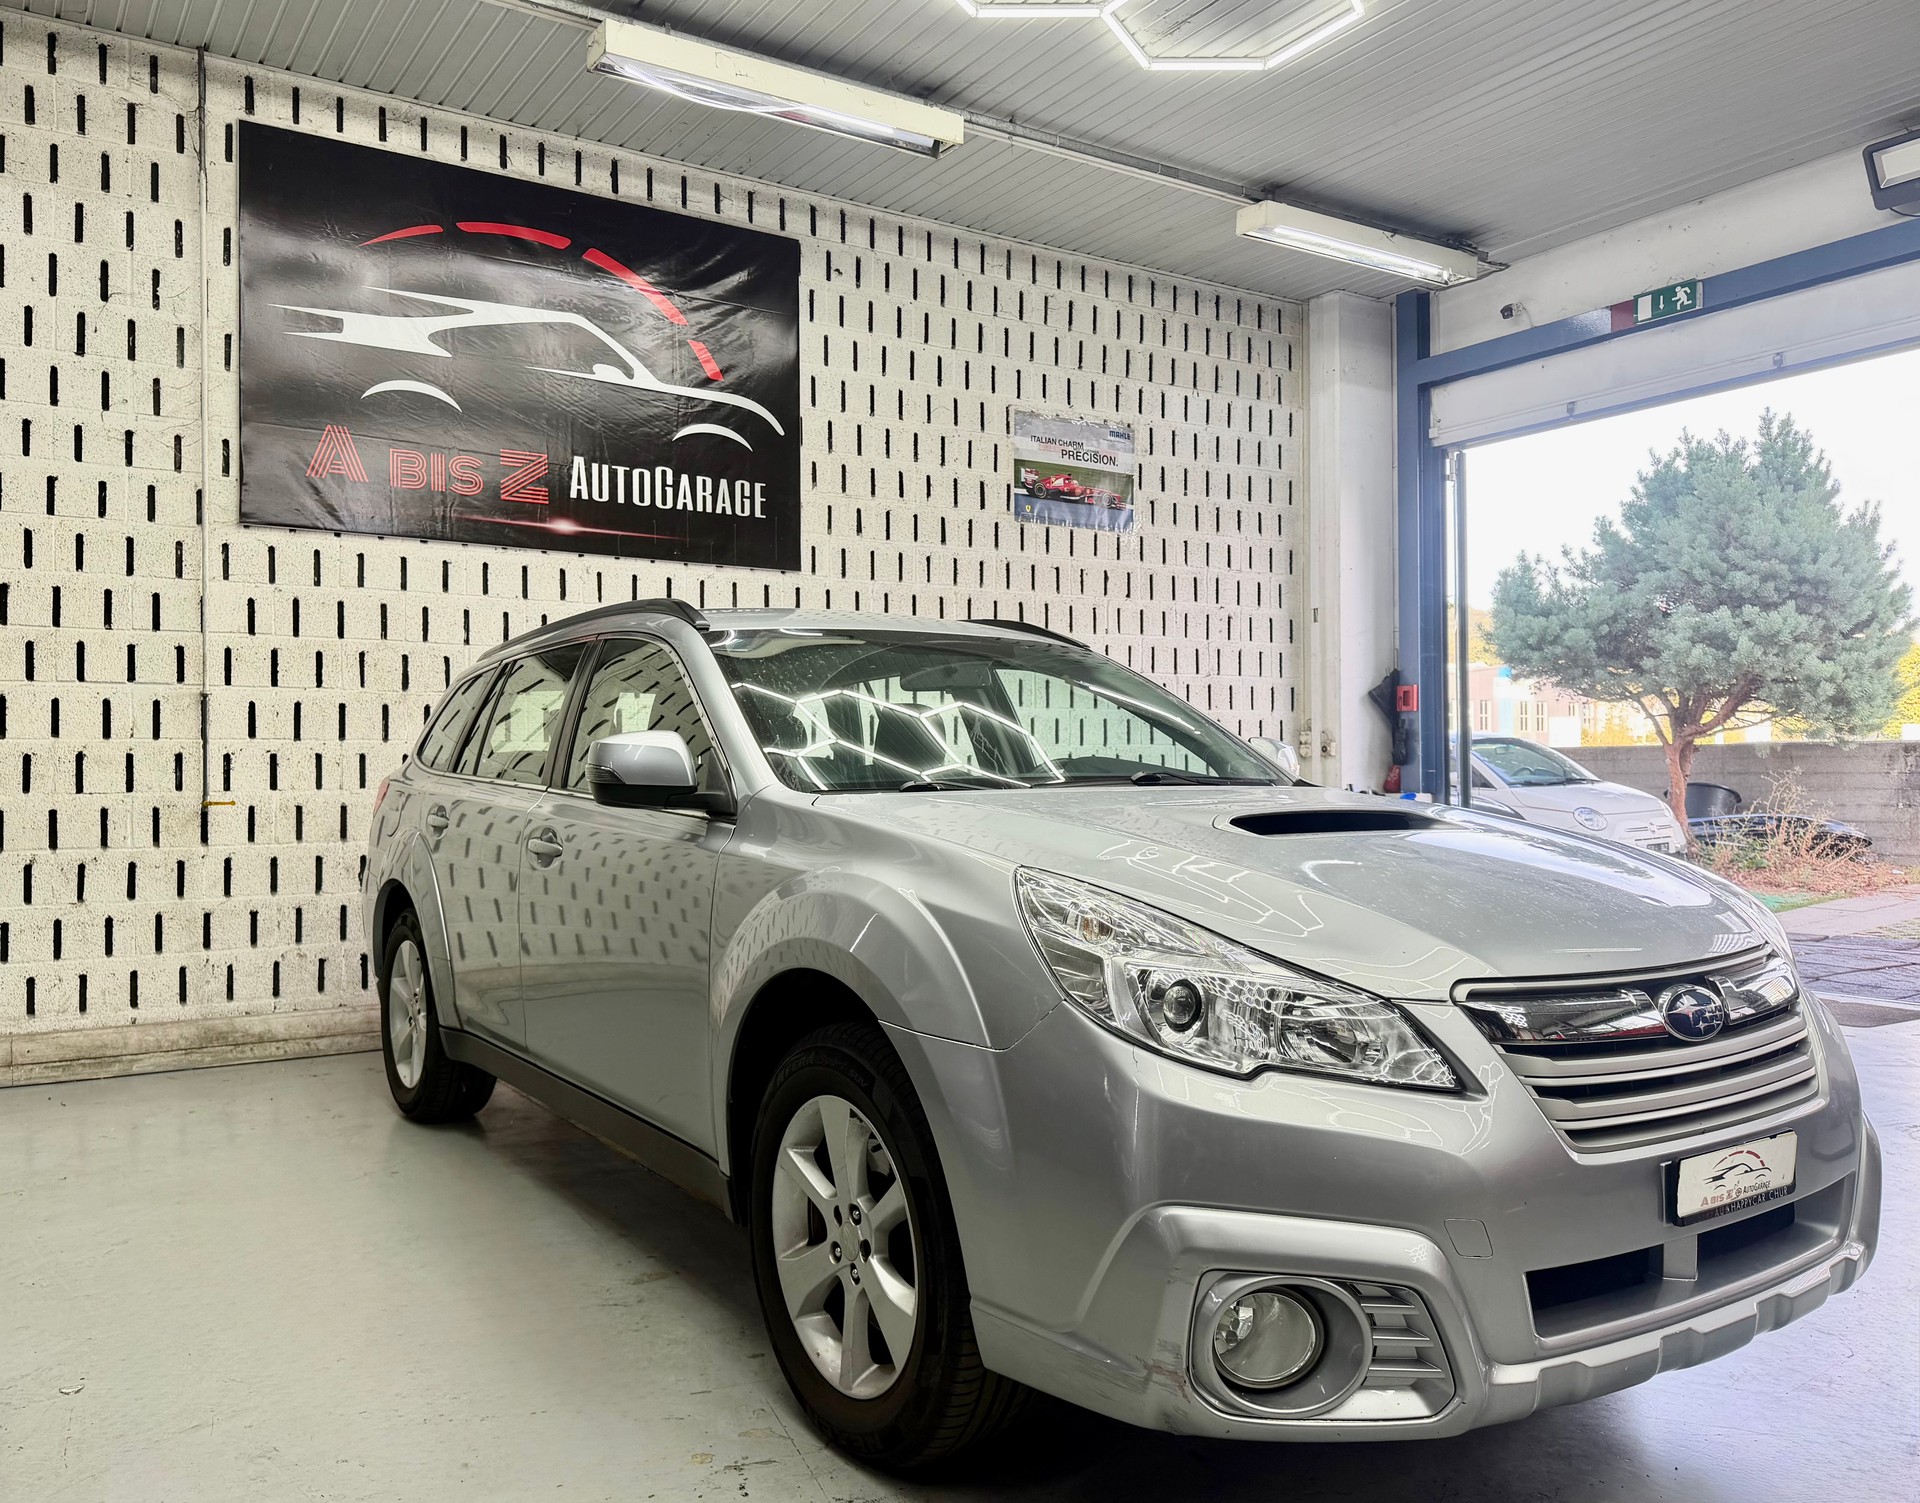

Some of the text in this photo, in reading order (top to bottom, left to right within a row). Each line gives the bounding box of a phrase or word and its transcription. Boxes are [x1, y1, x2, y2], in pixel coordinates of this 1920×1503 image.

[1030, 435, 1057, 445] ITALIAN
[1109, 430, 1131, 440] MAHLE
[306, 424, 369, 483] A
[389, 448, 484, 497] BIS
[500, 449, 549, 505] Z
[1700, 1196, 1709, 1207] A
[1710, 1193, 1725, 1204] BIS
[1768, 1186, 1789, 1200] CHUR
